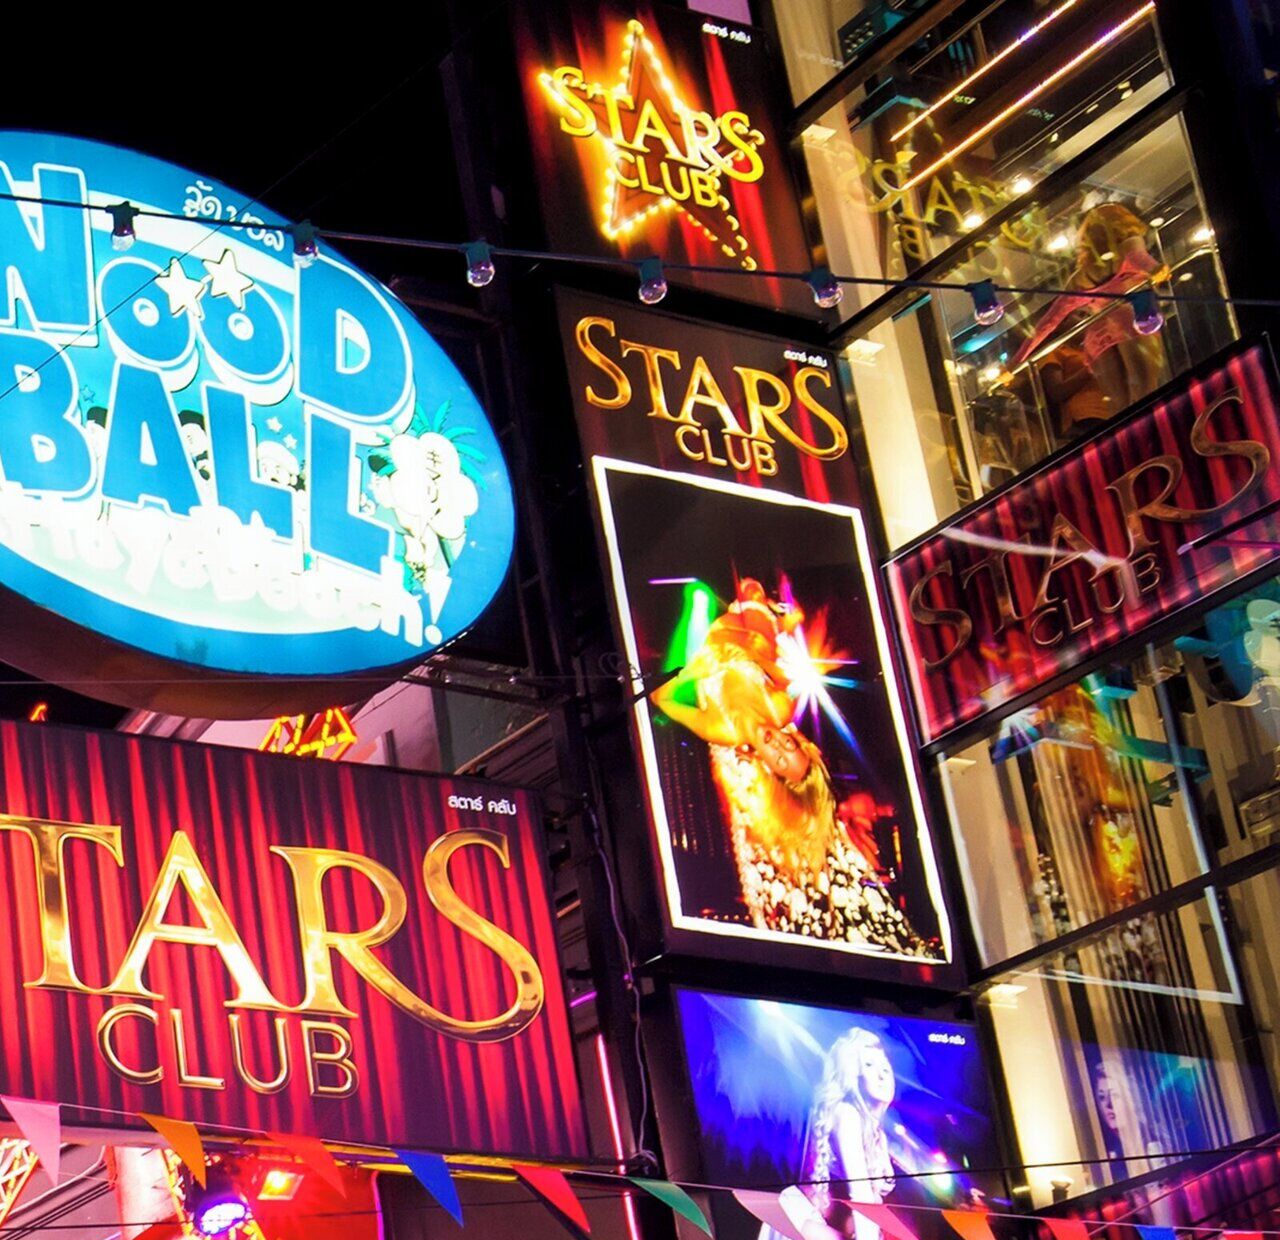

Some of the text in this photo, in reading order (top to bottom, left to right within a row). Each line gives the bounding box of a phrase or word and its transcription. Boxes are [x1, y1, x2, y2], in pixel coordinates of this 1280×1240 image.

[552, 66, 764, 184] STARS
[614, 156, 719, 208] CLUB
[575, 316, 848, 462] STARS
[676, 424, 777, 477] CLUB
[908, 388, 1270, 669] STARS
[1031, 552, 1160, 646] CLUB
[97, 1004, 359, 1098] CLUB
